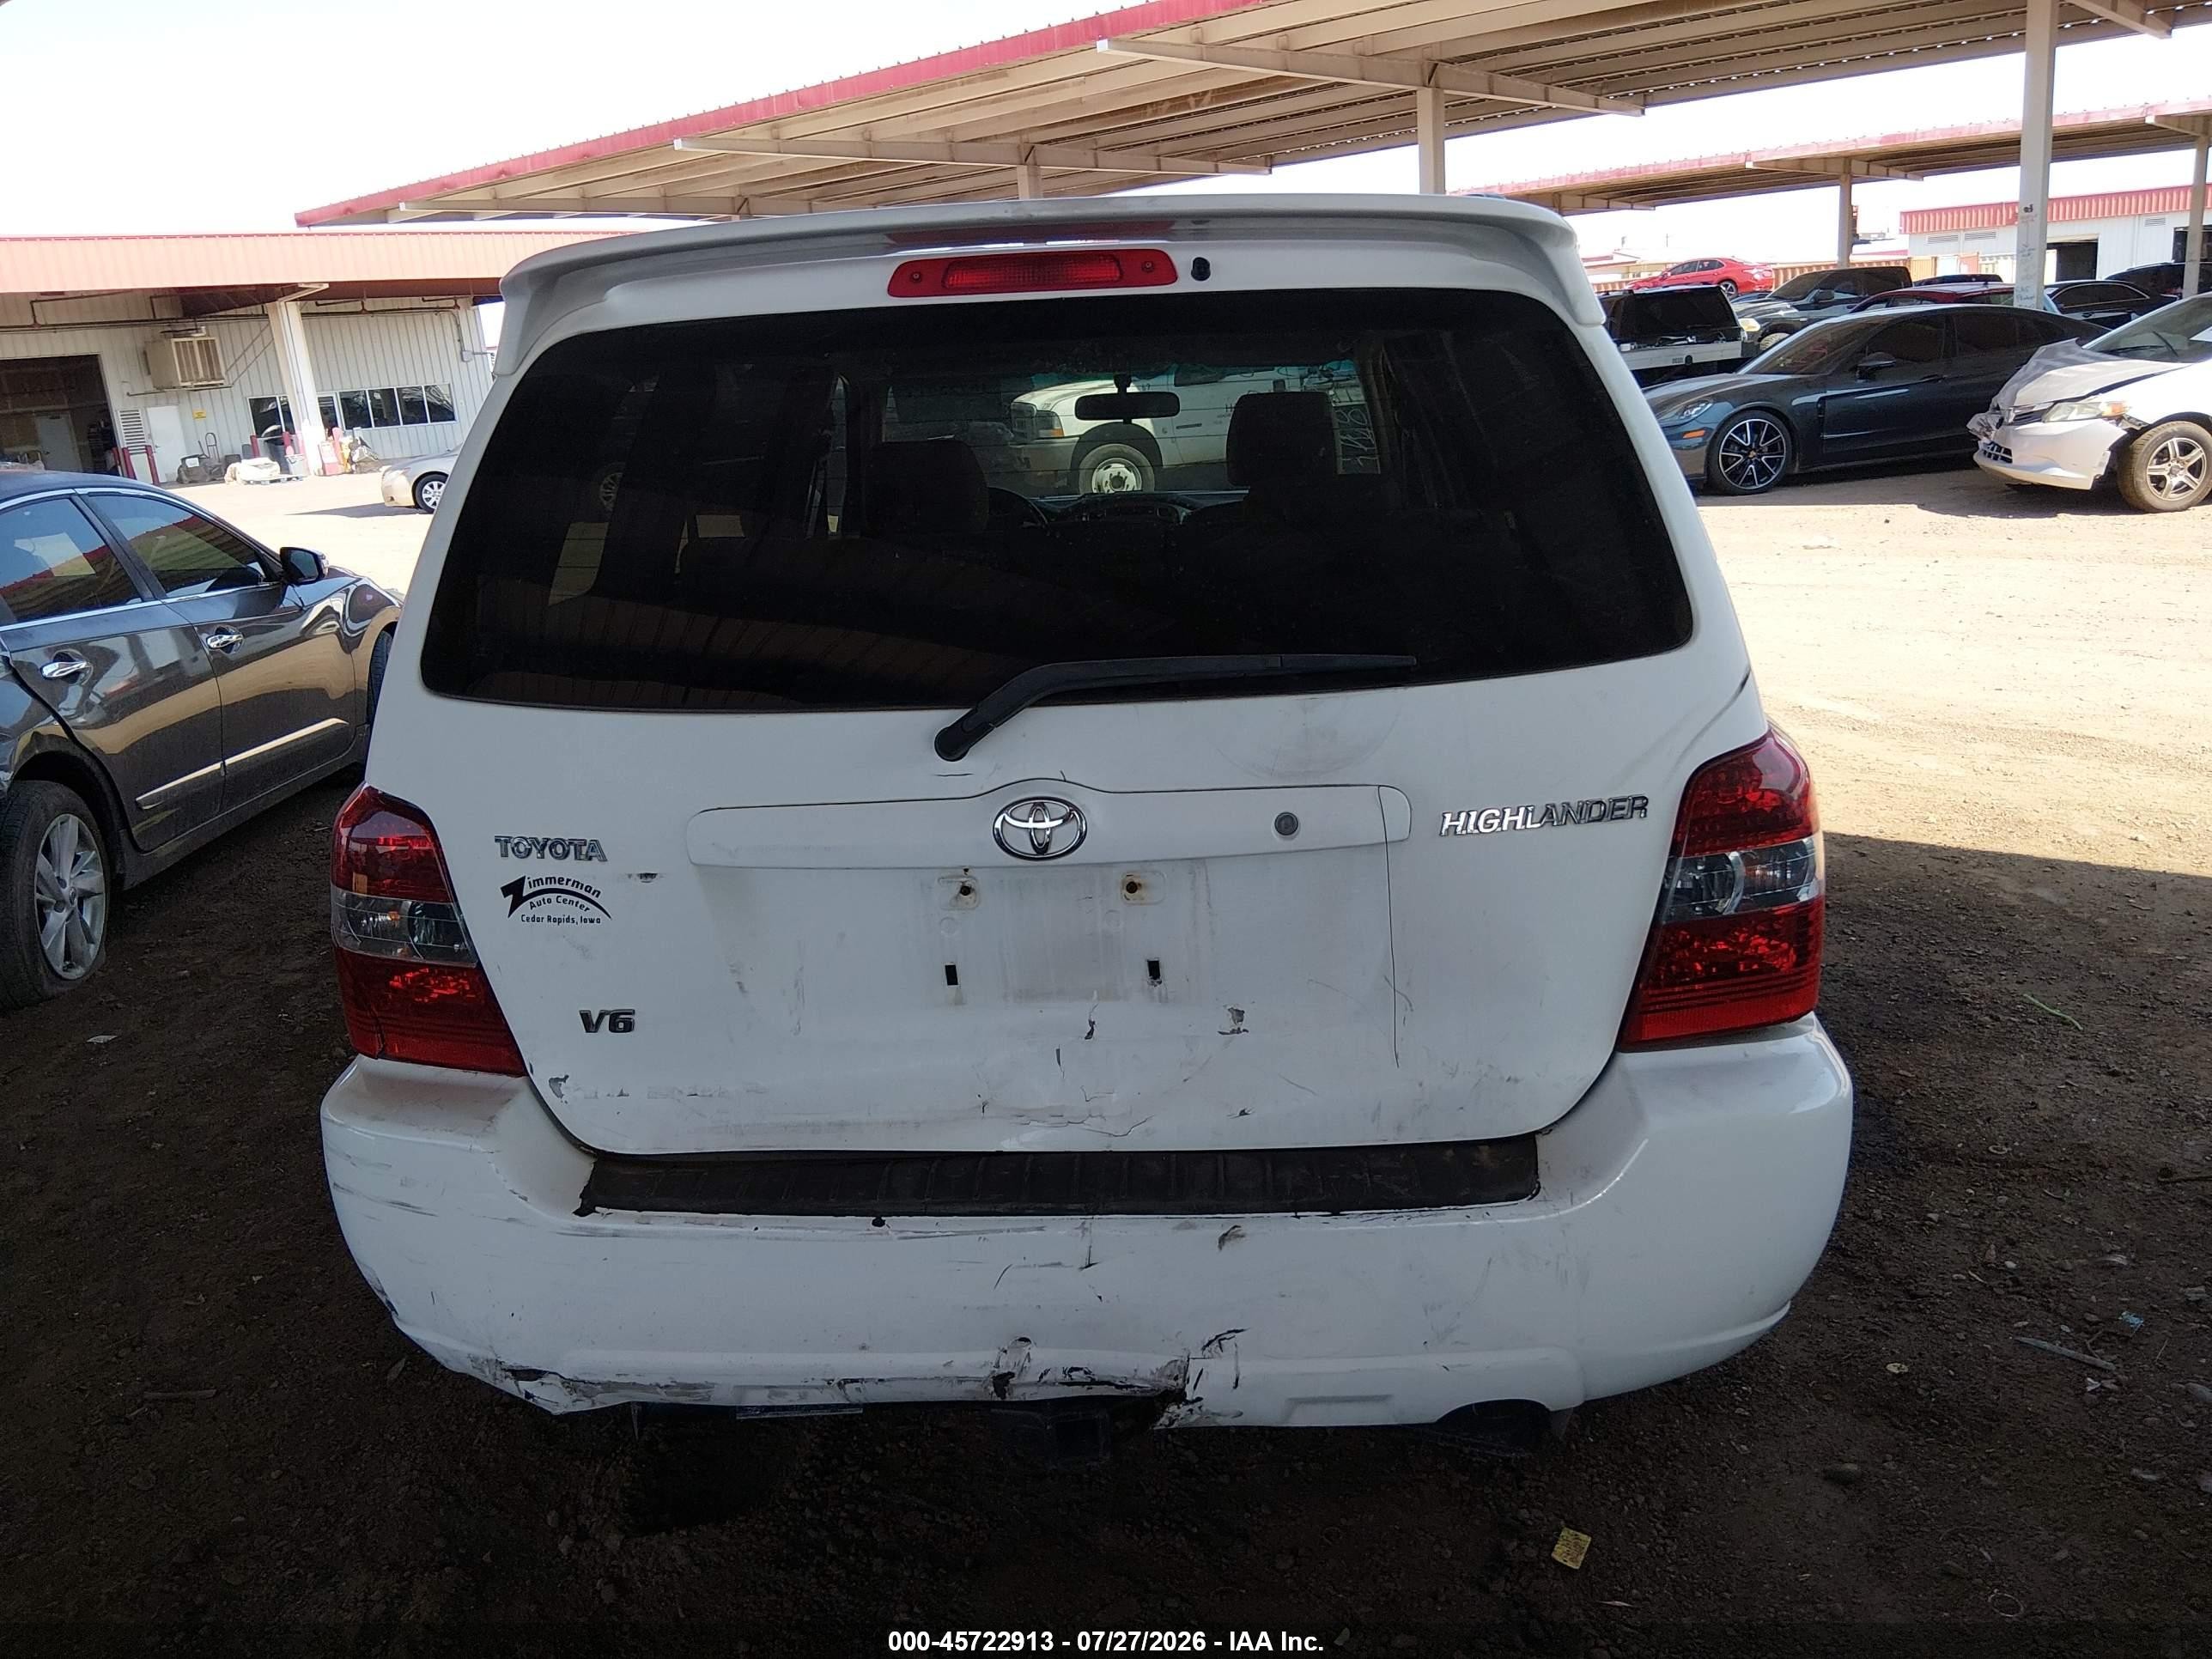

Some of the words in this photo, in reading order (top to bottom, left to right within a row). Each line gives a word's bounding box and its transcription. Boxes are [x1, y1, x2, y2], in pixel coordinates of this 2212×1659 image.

[1439, 793, 1649, 836] HIGHLANDER
[495, 836, 608, 862] TOYOTA
[501, 875, 604, 918] Zimmerman
[529, 896, 552, 910] Auto
[556, 896, 590, 912] Center
[547, 915, 578, 926] Rapids,
[579, 1008, 635, 1033] V6
